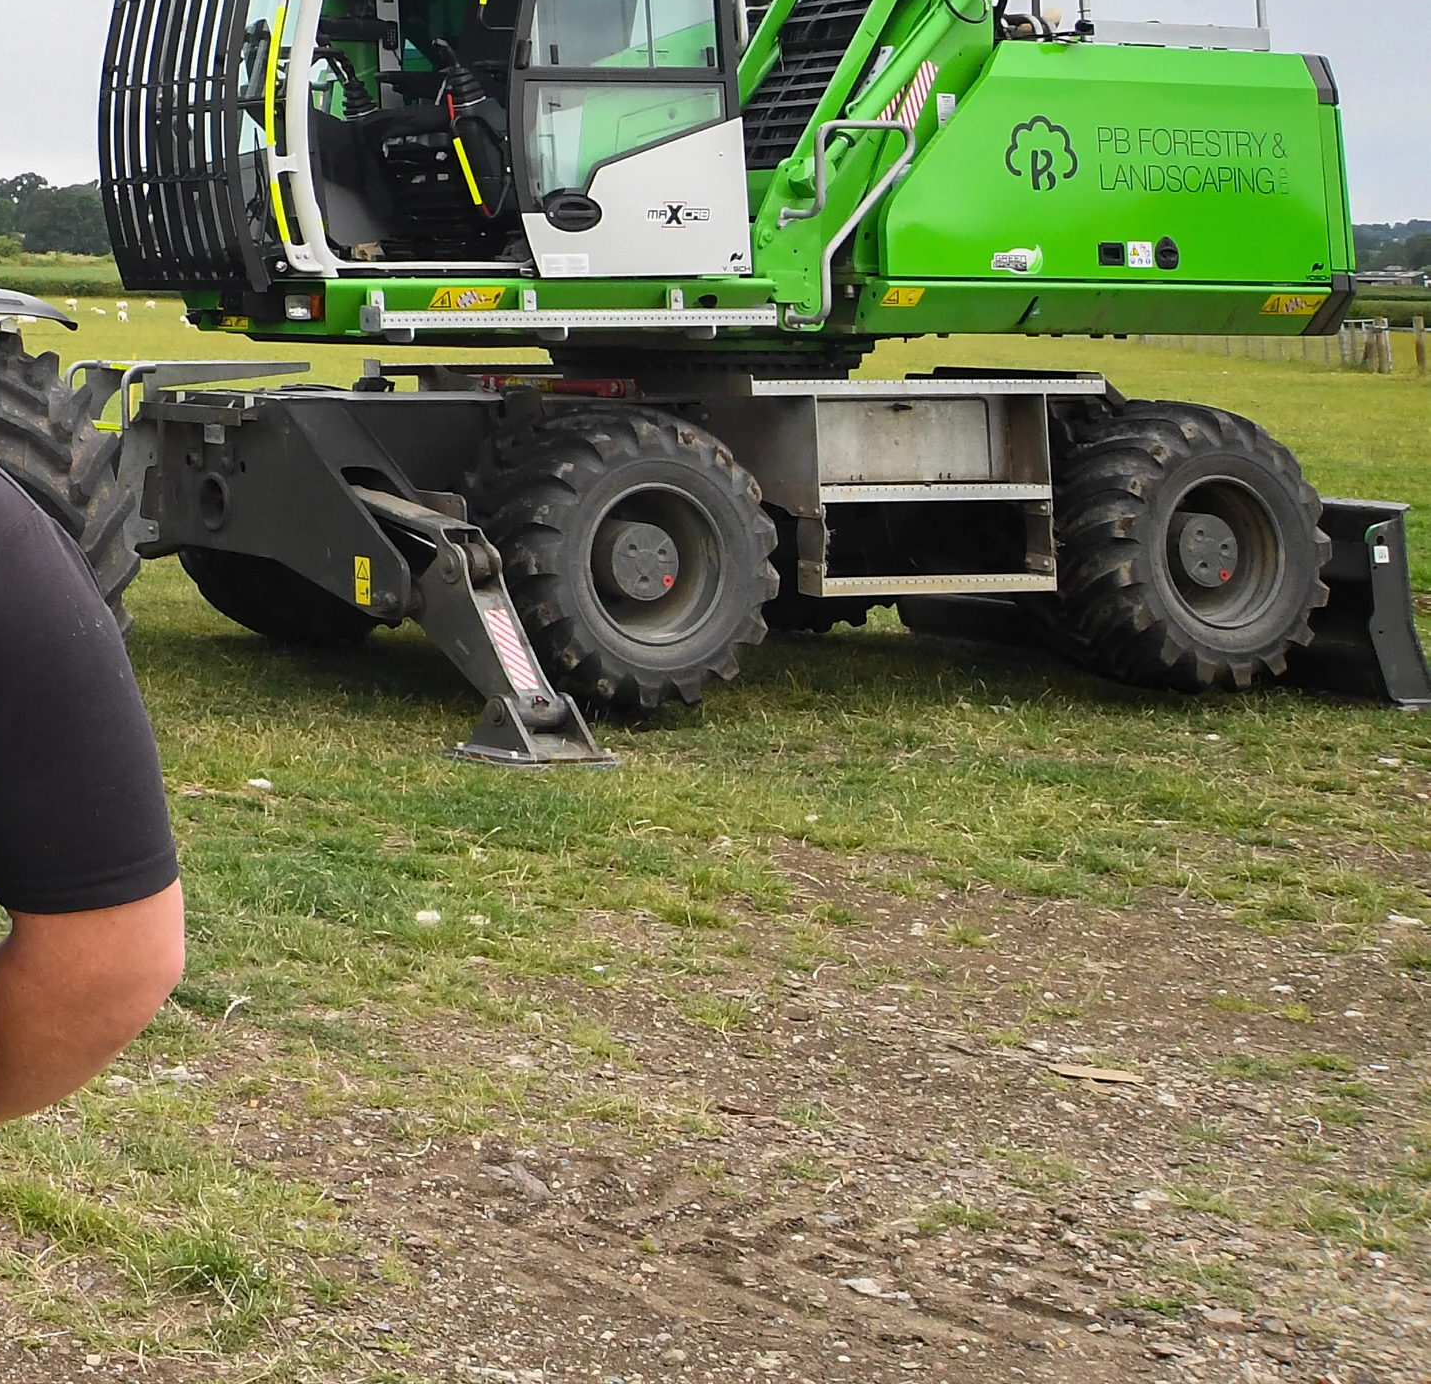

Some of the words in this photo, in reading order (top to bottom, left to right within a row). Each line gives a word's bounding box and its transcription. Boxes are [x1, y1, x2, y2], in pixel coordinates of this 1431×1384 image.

[1097, 127, 1131, 154] PB
[1139, 129, 1267, 158] FORESTRY
[1272, 132, 1287, 158] &
[1099, 164, 1275, 195] LANDSCAPING
